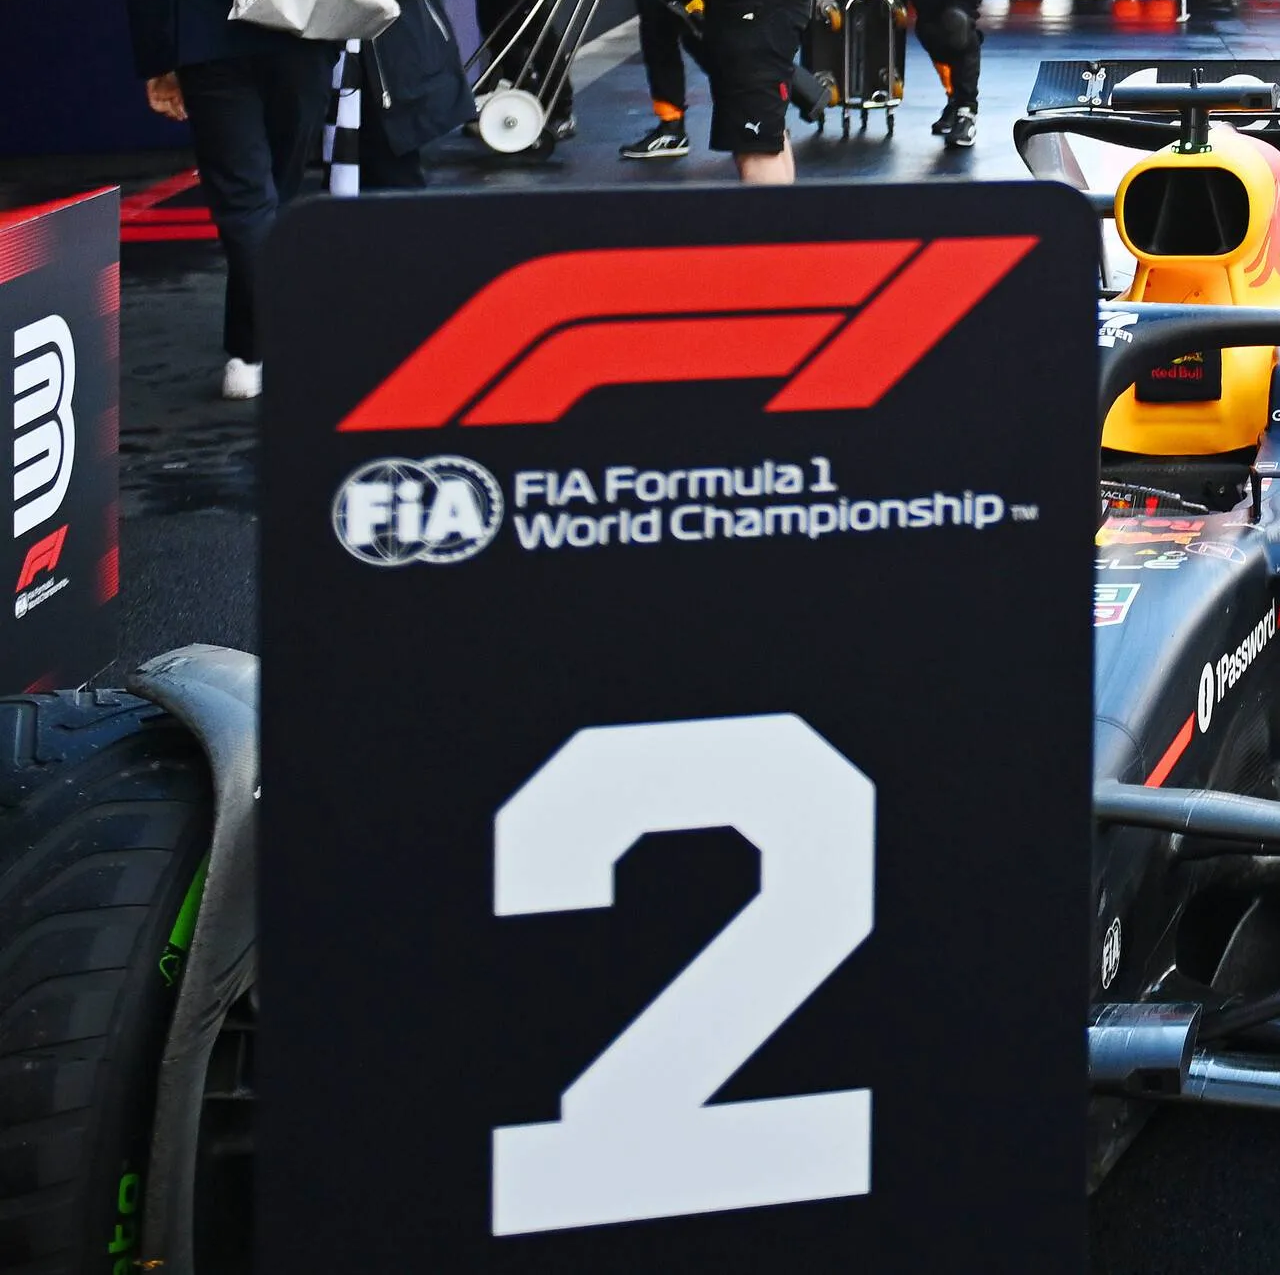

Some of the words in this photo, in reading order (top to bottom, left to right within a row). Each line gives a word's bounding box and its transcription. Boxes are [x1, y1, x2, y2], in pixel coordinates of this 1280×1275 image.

[337, 236, 1041, 432] F1
[14, 314, 76, 538] 3
[514, 468, 598, 508] FIA
[604, 461, 803, 502] Formula
[809, 457, 839, 494] 1
[513, 509, 661, 551] World
[669, 491, 1003, 540] Championship
[1215, 597, 1276, 703] 1Password
[491, 712, 876, 1236] 2
